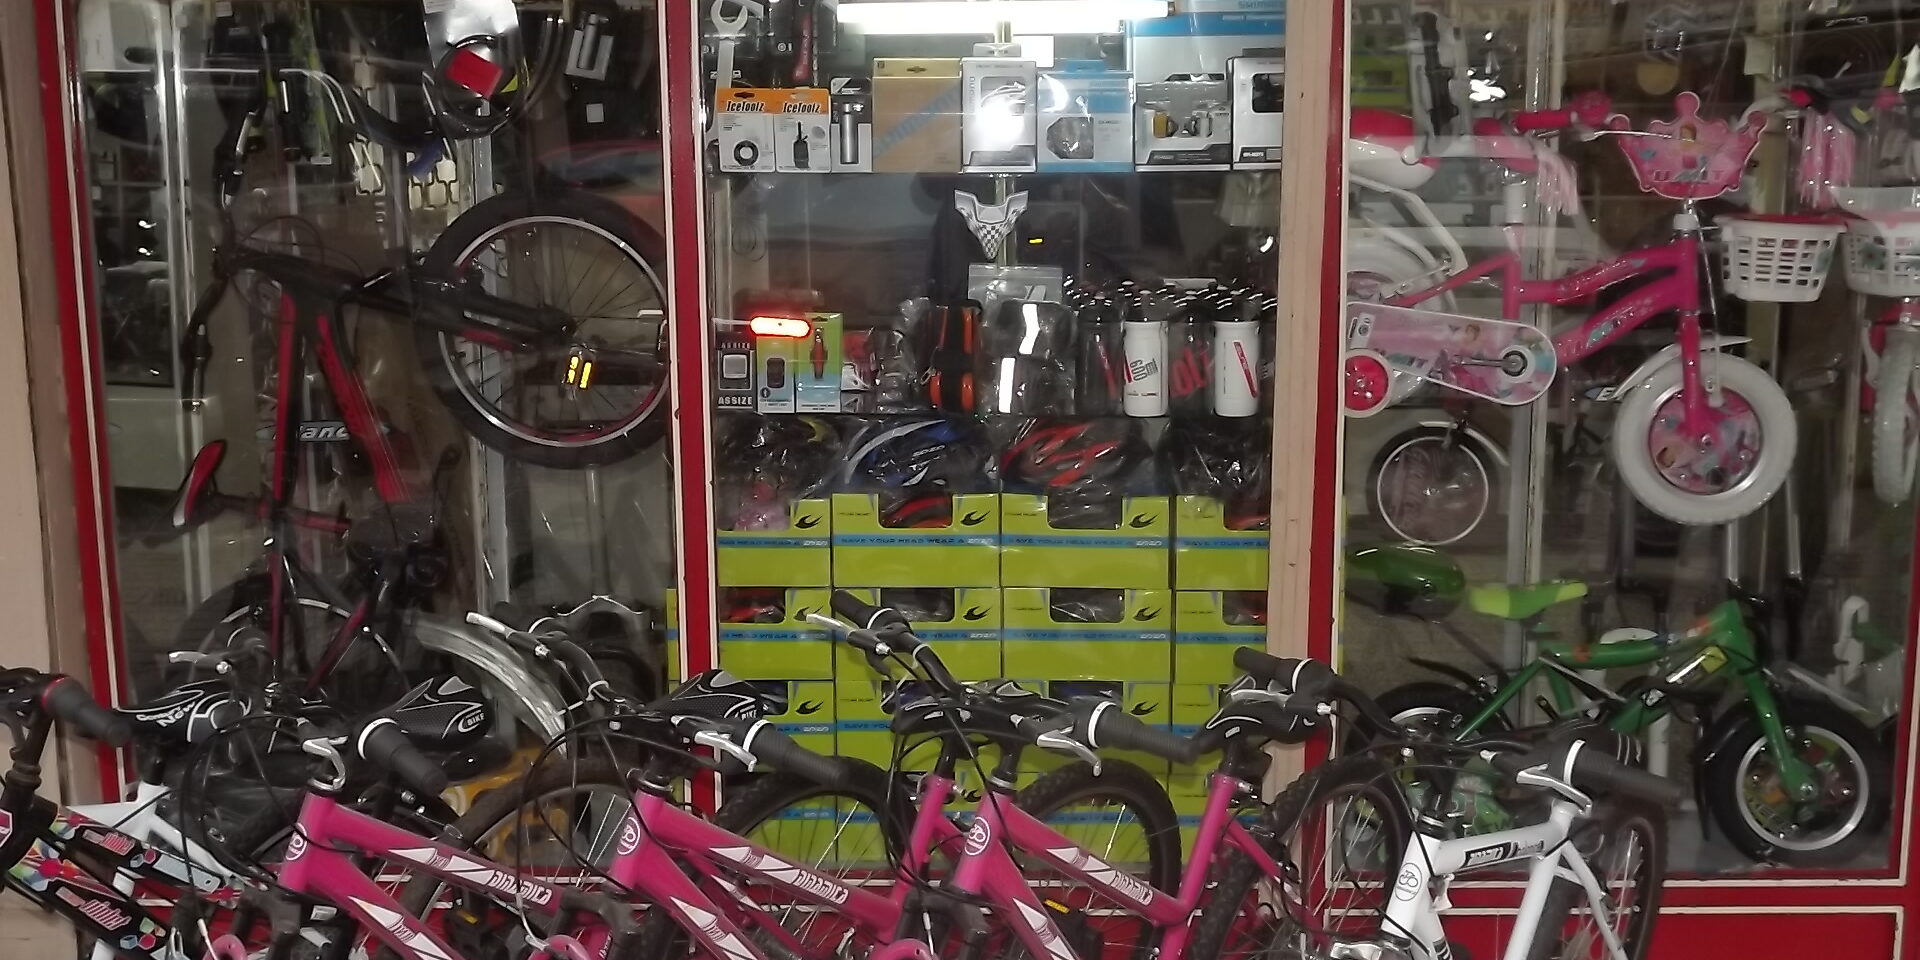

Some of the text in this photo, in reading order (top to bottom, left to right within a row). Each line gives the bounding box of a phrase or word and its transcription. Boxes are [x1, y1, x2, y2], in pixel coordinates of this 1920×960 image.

[726, 101, 766, 112] IceToolz
[782, 102, 822, 113] IceToolz
[717, 396, 753, 405] ASSIZE
[466, 712, 485, 726] BIKE
